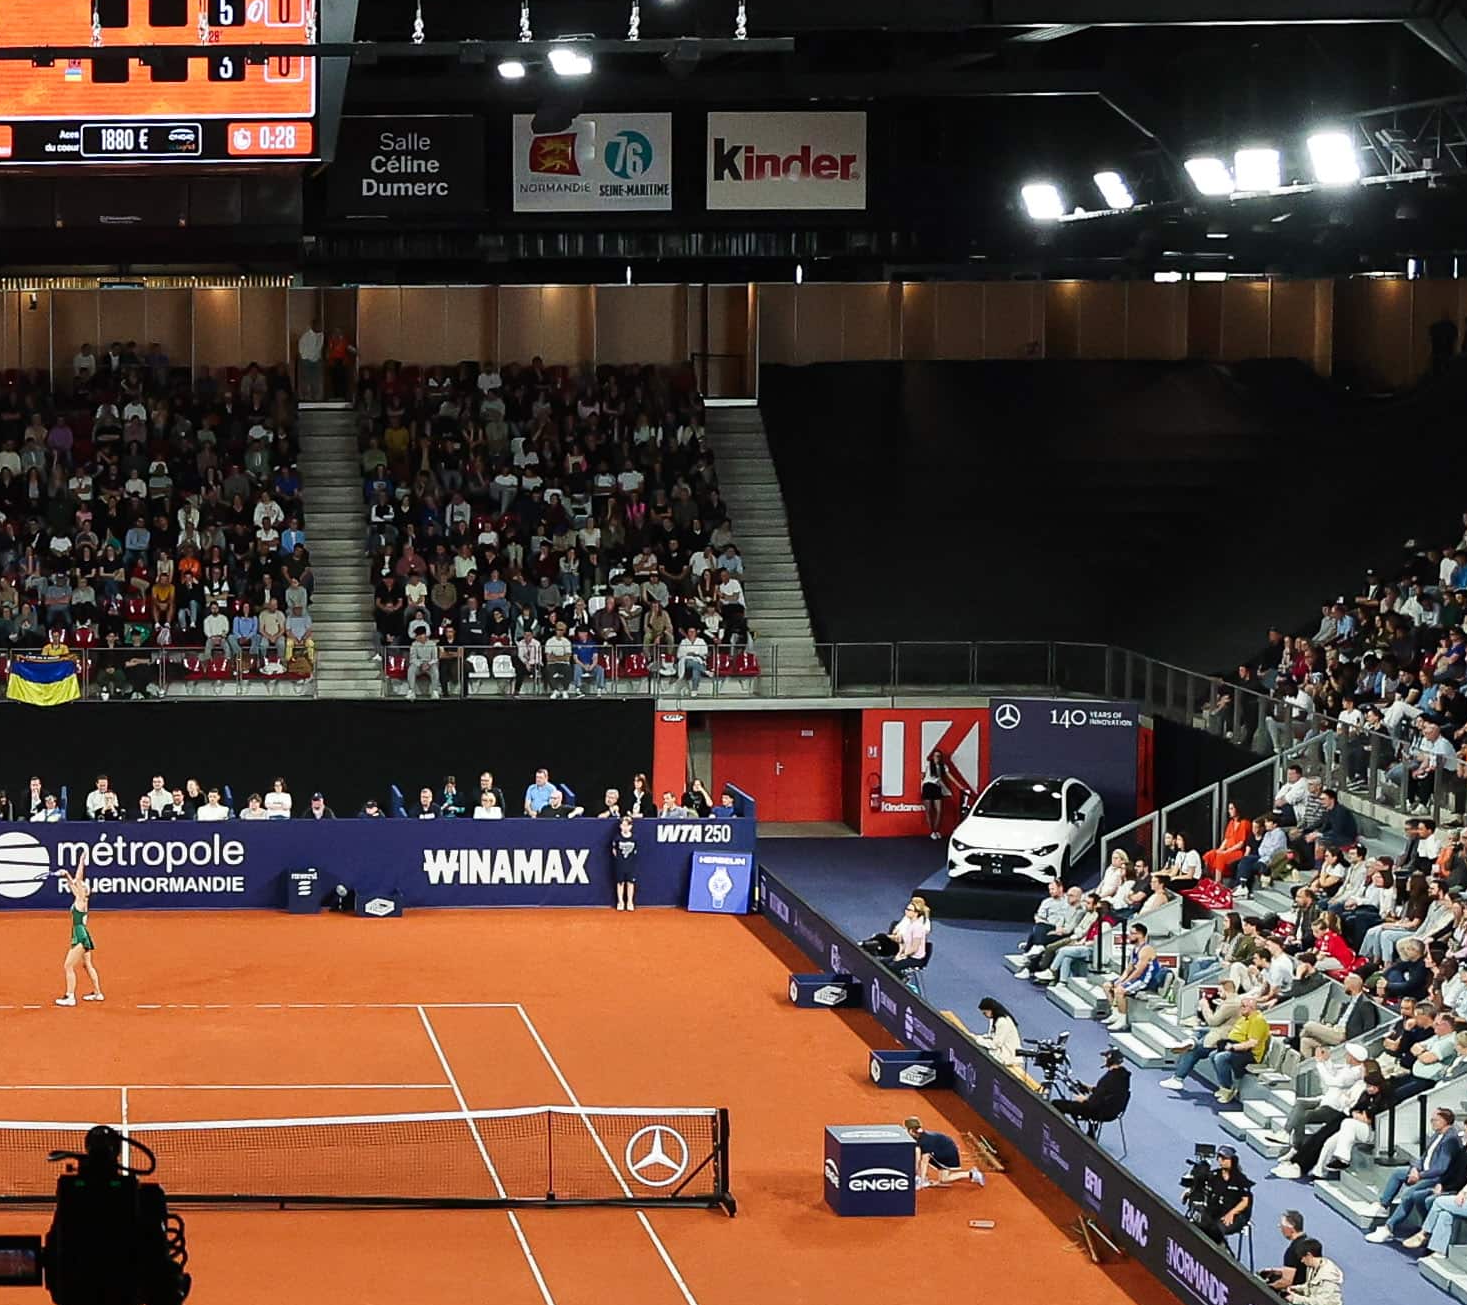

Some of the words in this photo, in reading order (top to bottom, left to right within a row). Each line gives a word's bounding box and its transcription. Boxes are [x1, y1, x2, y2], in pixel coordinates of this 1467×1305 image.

[101, 128, 134, 151] 1880
[138, 128, 149, 150] €
[260, 126, 296, 148] 0:28
[379, 132, 432, 152] Salle
[370, 154, 440, 174] Céline
[612, 135, 646, 176] 76
[361, 178, 449, 198] Dumerc
[519, 183, 591, 193] NORMANDIE
[1049, 709, 1087, 729] 140
[881, 801, 926, 813] Kindaren
[657, 824, 702, 843] WTA
[705, 824, 731, 843] 250
[58, 832, 244, 874] métropole
[423, 849, 590, 884] WINAMAX
[1121, 1198, 1149, 1247] RMC
